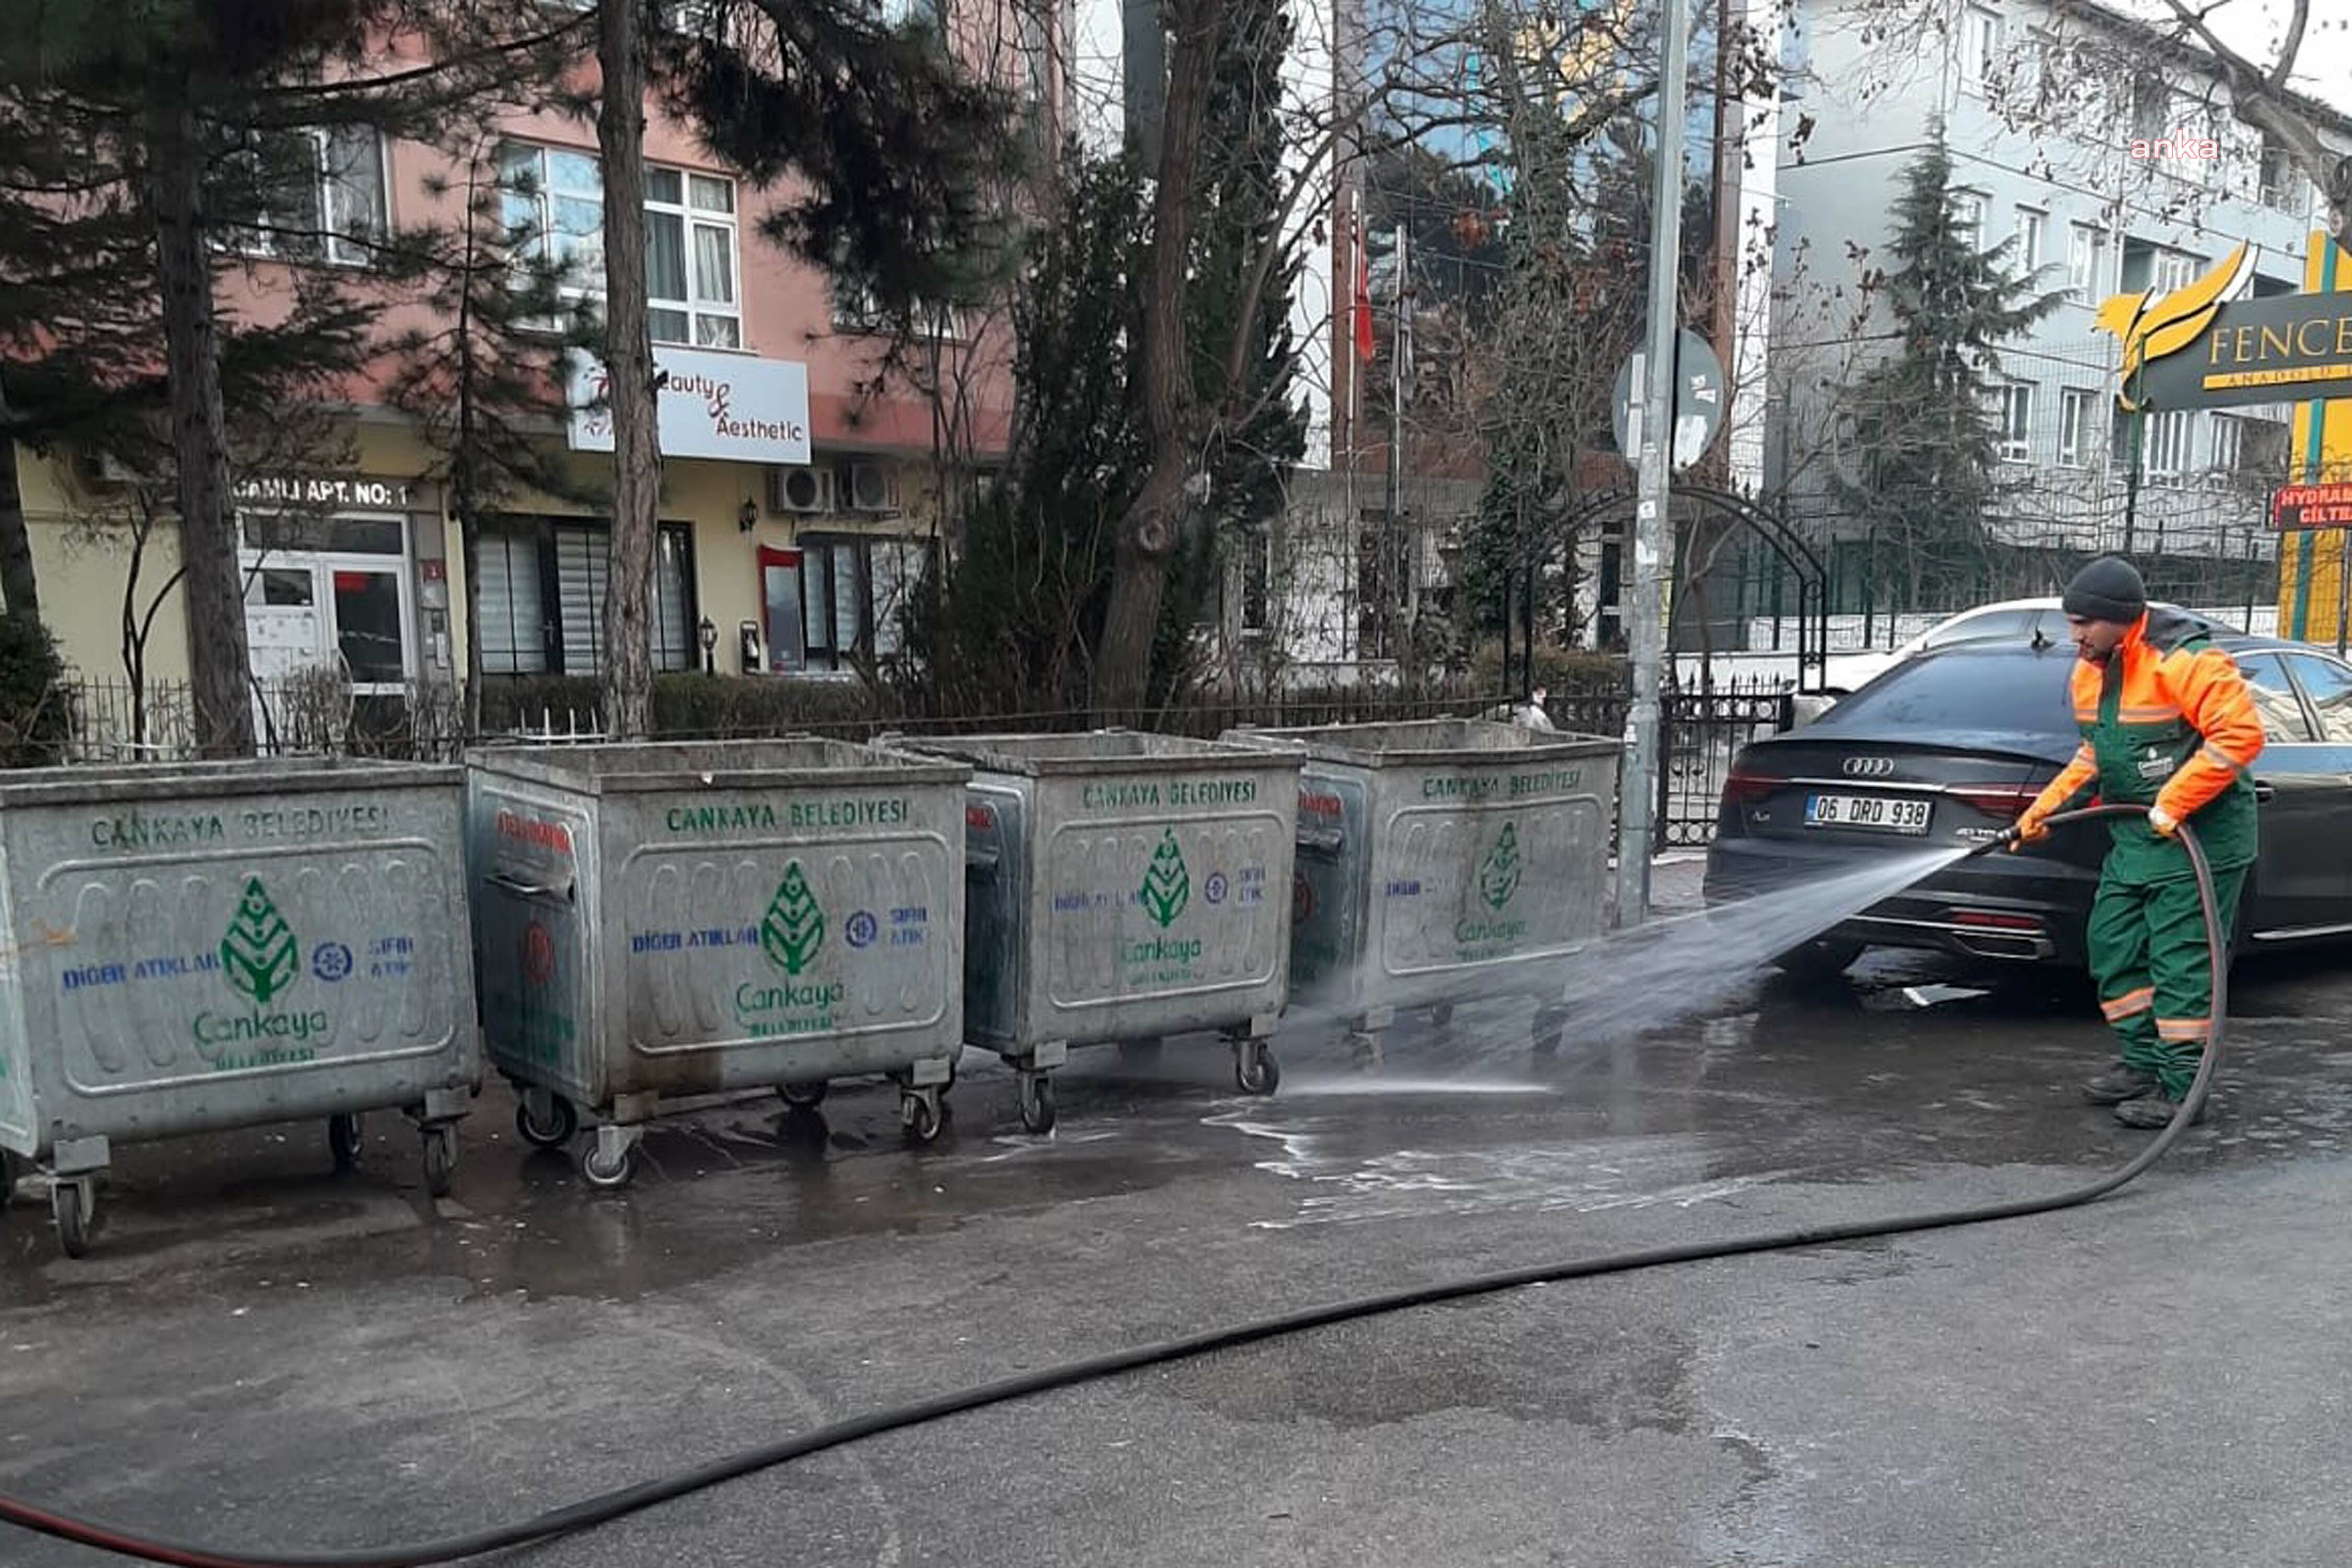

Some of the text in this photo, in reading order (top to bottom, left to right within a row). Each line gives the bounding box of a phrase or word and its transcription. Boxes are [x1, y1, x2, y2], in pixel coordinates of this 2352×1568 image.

[307, 480, 350, 503] APT.
[356, 483, 392, 505] NO:
[1817, 798, 1839, 820] 06
[1892, 802, 1926, 825] 938
